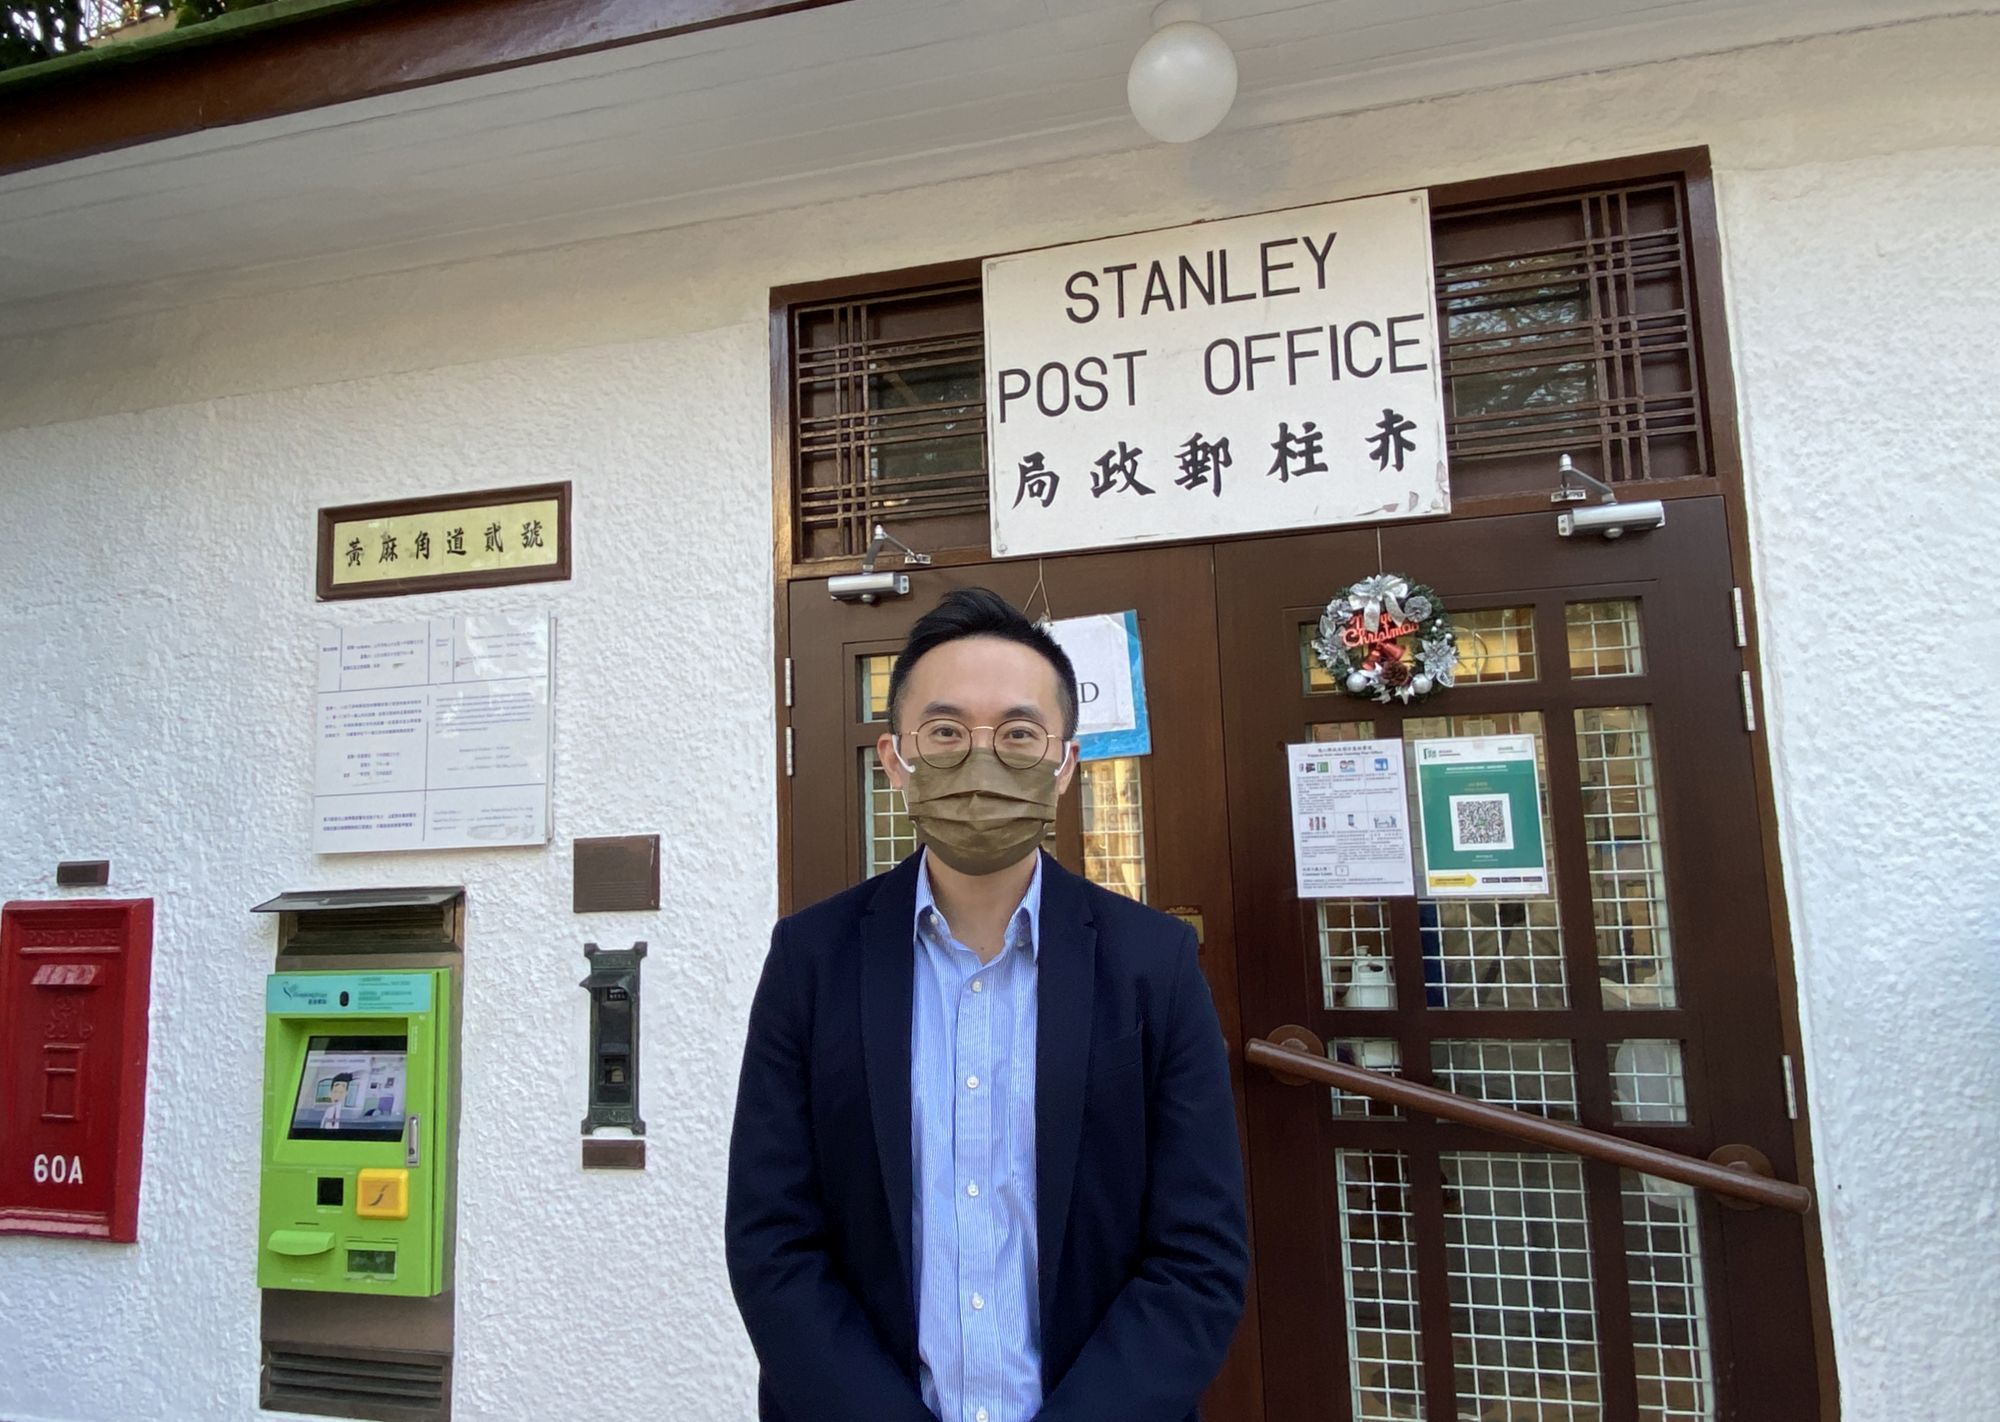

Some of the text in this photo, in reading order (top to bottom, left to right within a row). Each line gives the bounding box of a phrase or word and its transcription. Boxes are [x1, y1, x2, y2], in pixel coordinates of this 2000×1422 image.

[1065, 232, 1337, 324] STANLEY
[998, 313, 1428, 423] POST OFFICE
[33, 1153, 84, 1185] 60A
